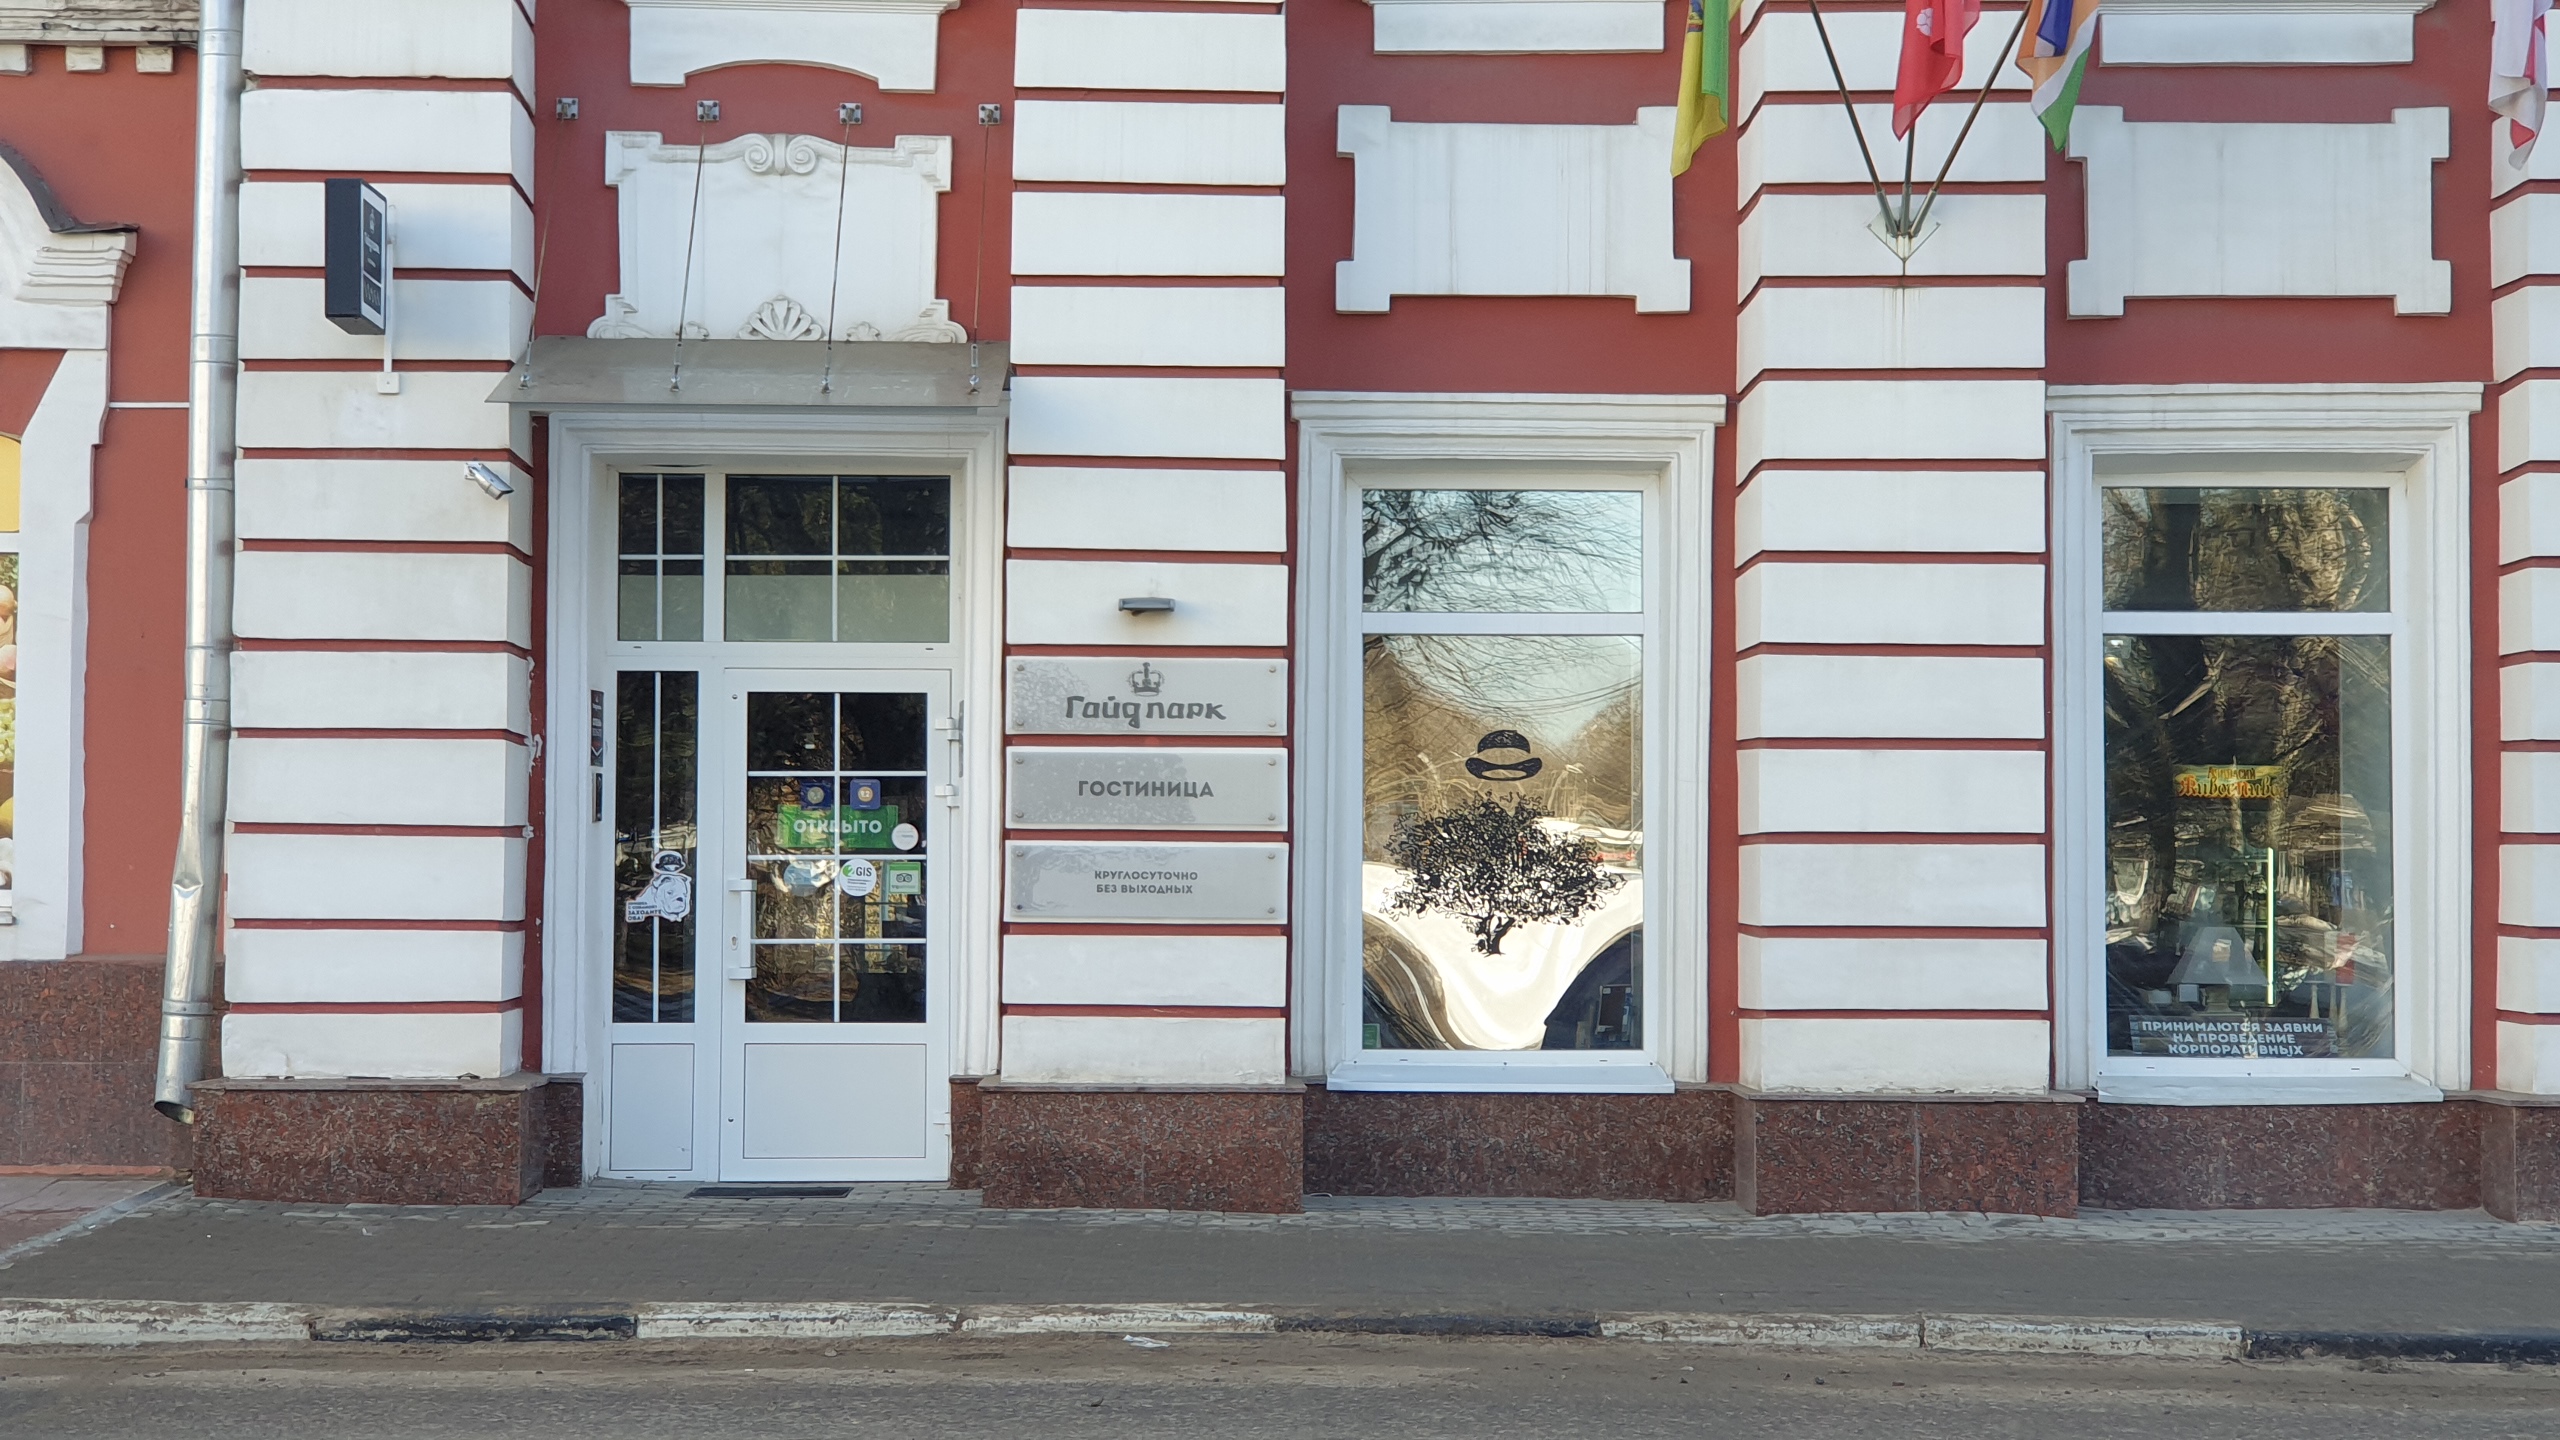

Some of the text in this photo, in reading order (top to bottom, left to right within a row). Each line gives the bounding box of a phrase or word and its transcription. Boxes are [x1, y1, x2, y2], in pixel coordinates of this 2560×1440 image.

[1066, 696, 1141, 728] Гайд
[1078, 780, 1214, 798] ГОСТИНИЦА
[1095, 870, 1198, 881] КРУГЛОСУТОЧНО
[1096, 884, 1193, 894] БЕЗ ВЫХОДНЫХ
[2142, 1021, 2323, 1033] ПРИНИМАЮТСЯ ЗАЯВКИ
[2173, 1033, 2296, 1044] НА ПРОВЕДЕНИЕ
[2168, 1044, 2304, 1056] КОРПОРАТИВНЫХ
